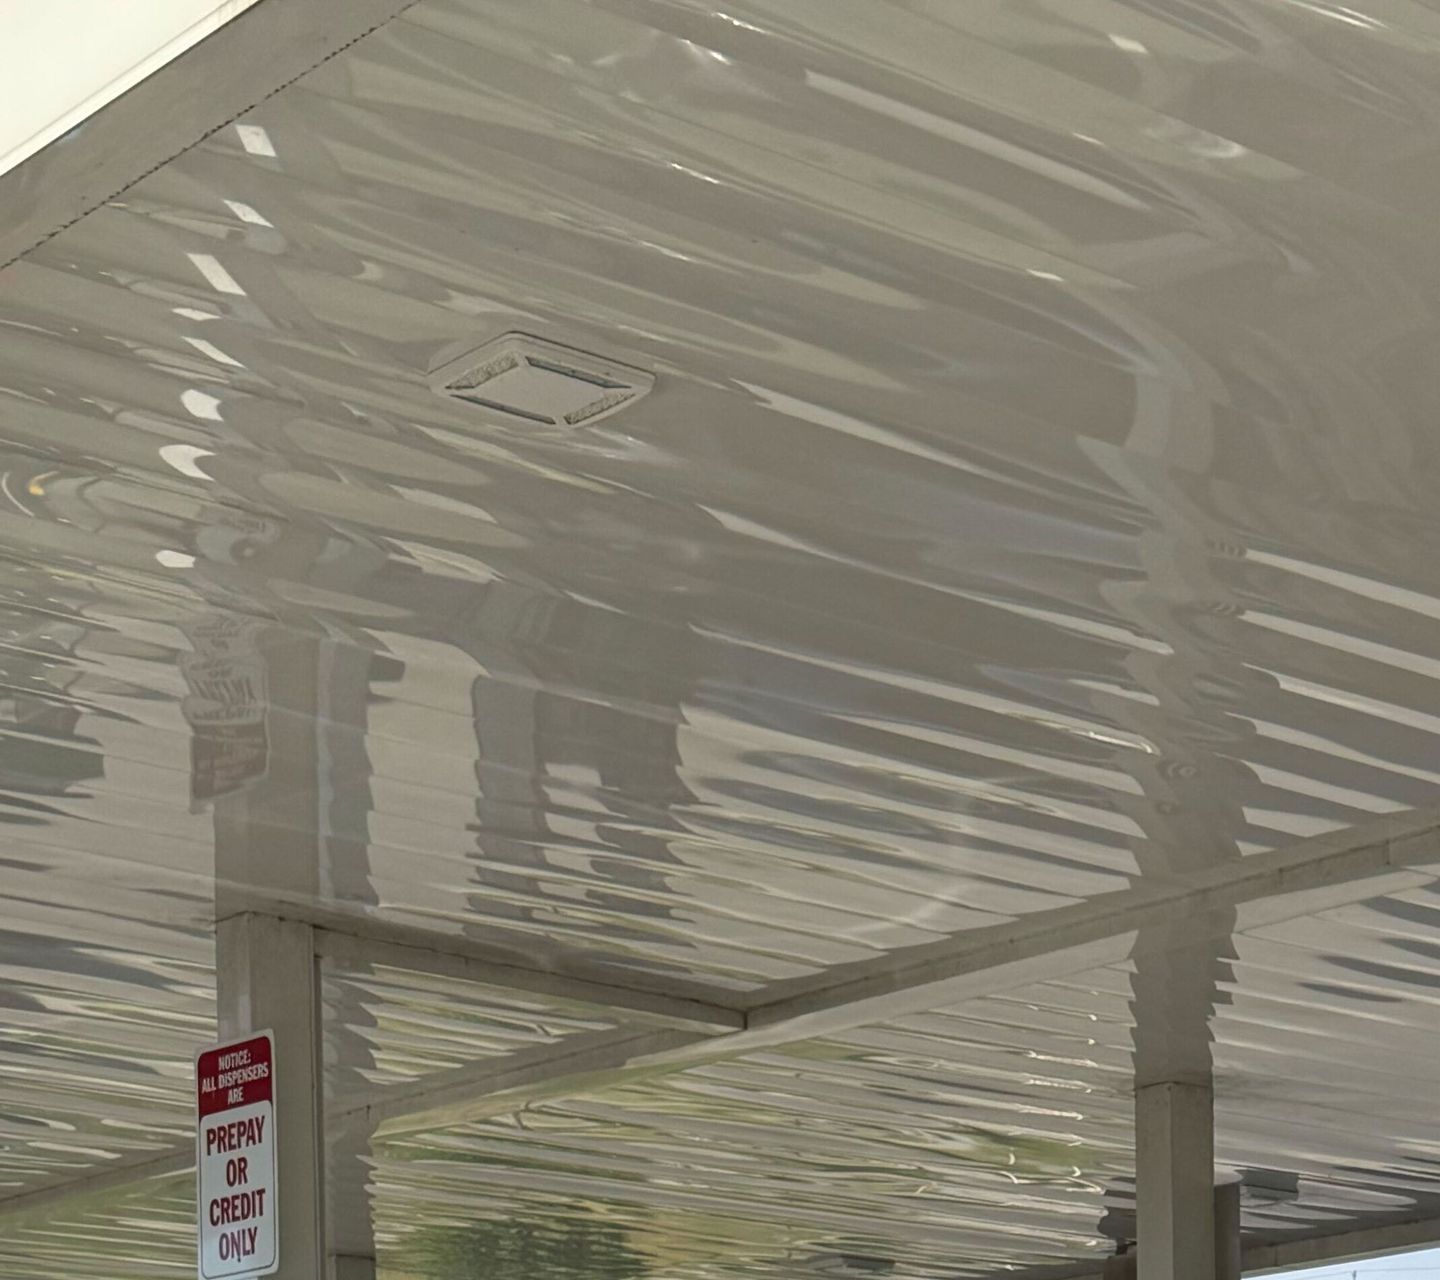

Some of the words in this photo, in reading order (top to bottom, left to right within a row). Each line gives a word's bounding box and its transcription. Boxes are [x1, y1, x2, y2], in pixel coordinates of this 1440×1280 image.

[218, 1049, 251, 1071] NOTICE:
[202, 1077, 216, 1094] ALL
[218, 1062, 268, 1088] DISPENSERS
[228, 1086, 244, 1105] ARE
[206, 1115, 265, 1156] PREPAY
[226, 1156, 248, 1187] OR
[209, 1188, 266, 1227] CREDIT
[219, 1226, 258, 1261] ONLY
